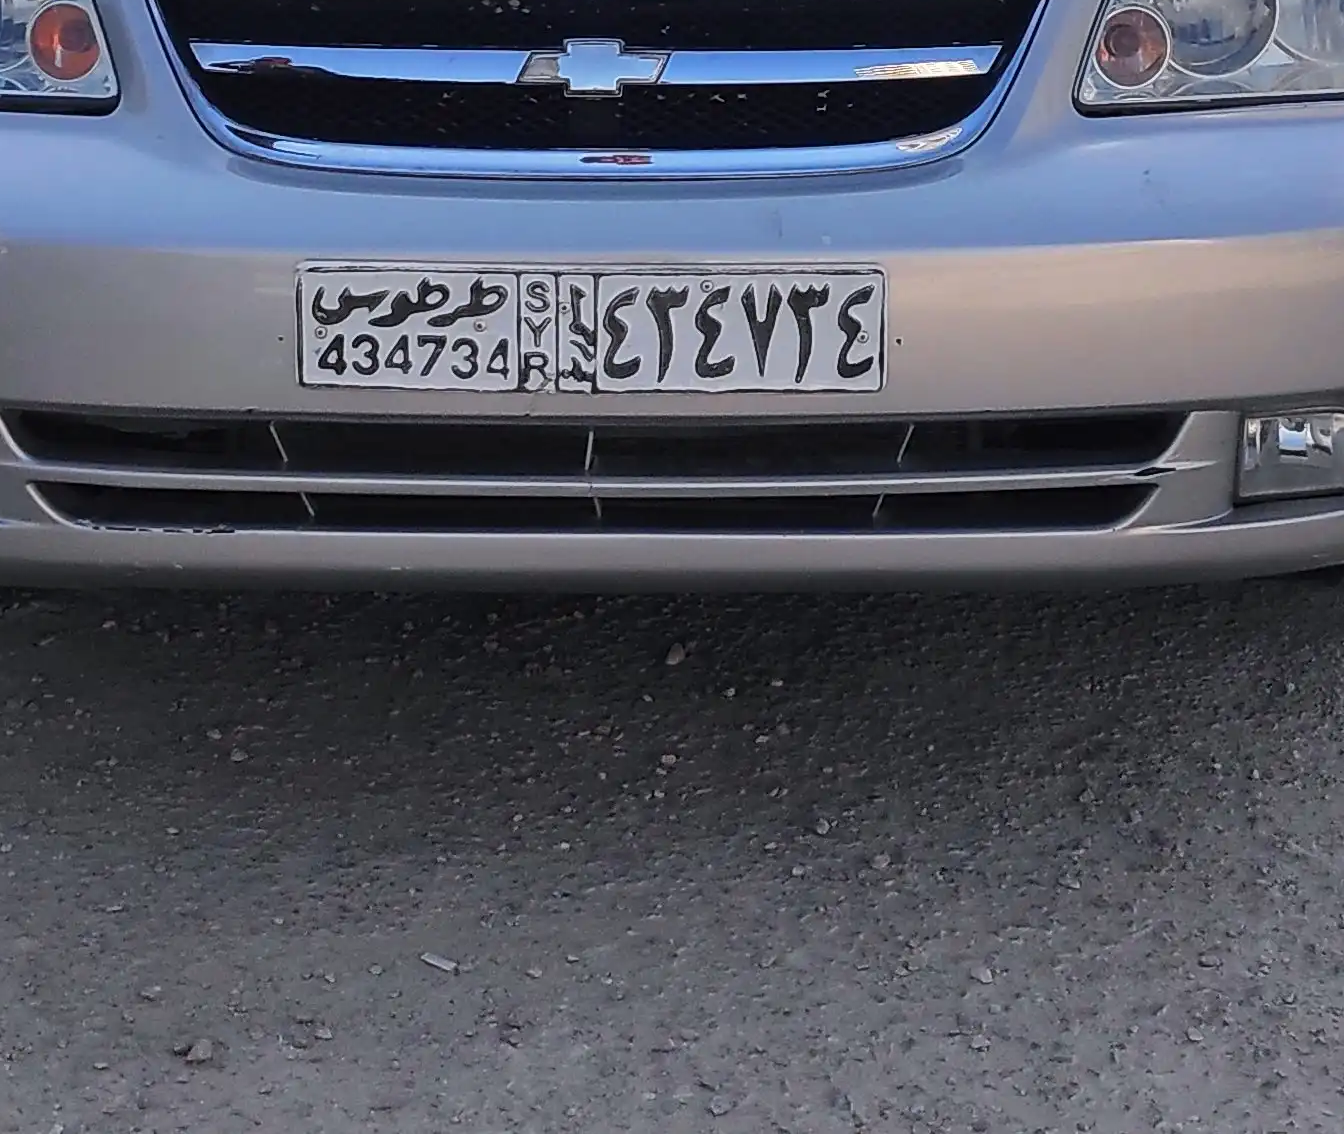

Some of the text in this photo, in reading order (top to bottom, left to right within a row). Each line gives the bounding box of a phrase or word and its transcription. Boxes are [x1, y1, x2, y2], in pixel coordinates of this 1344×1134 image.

[311, 276, 510, 328] طرطوس
[317, 333, 511, 381] 434734
[602, 283, 875, 384] ٤٣٤٧٣٤
